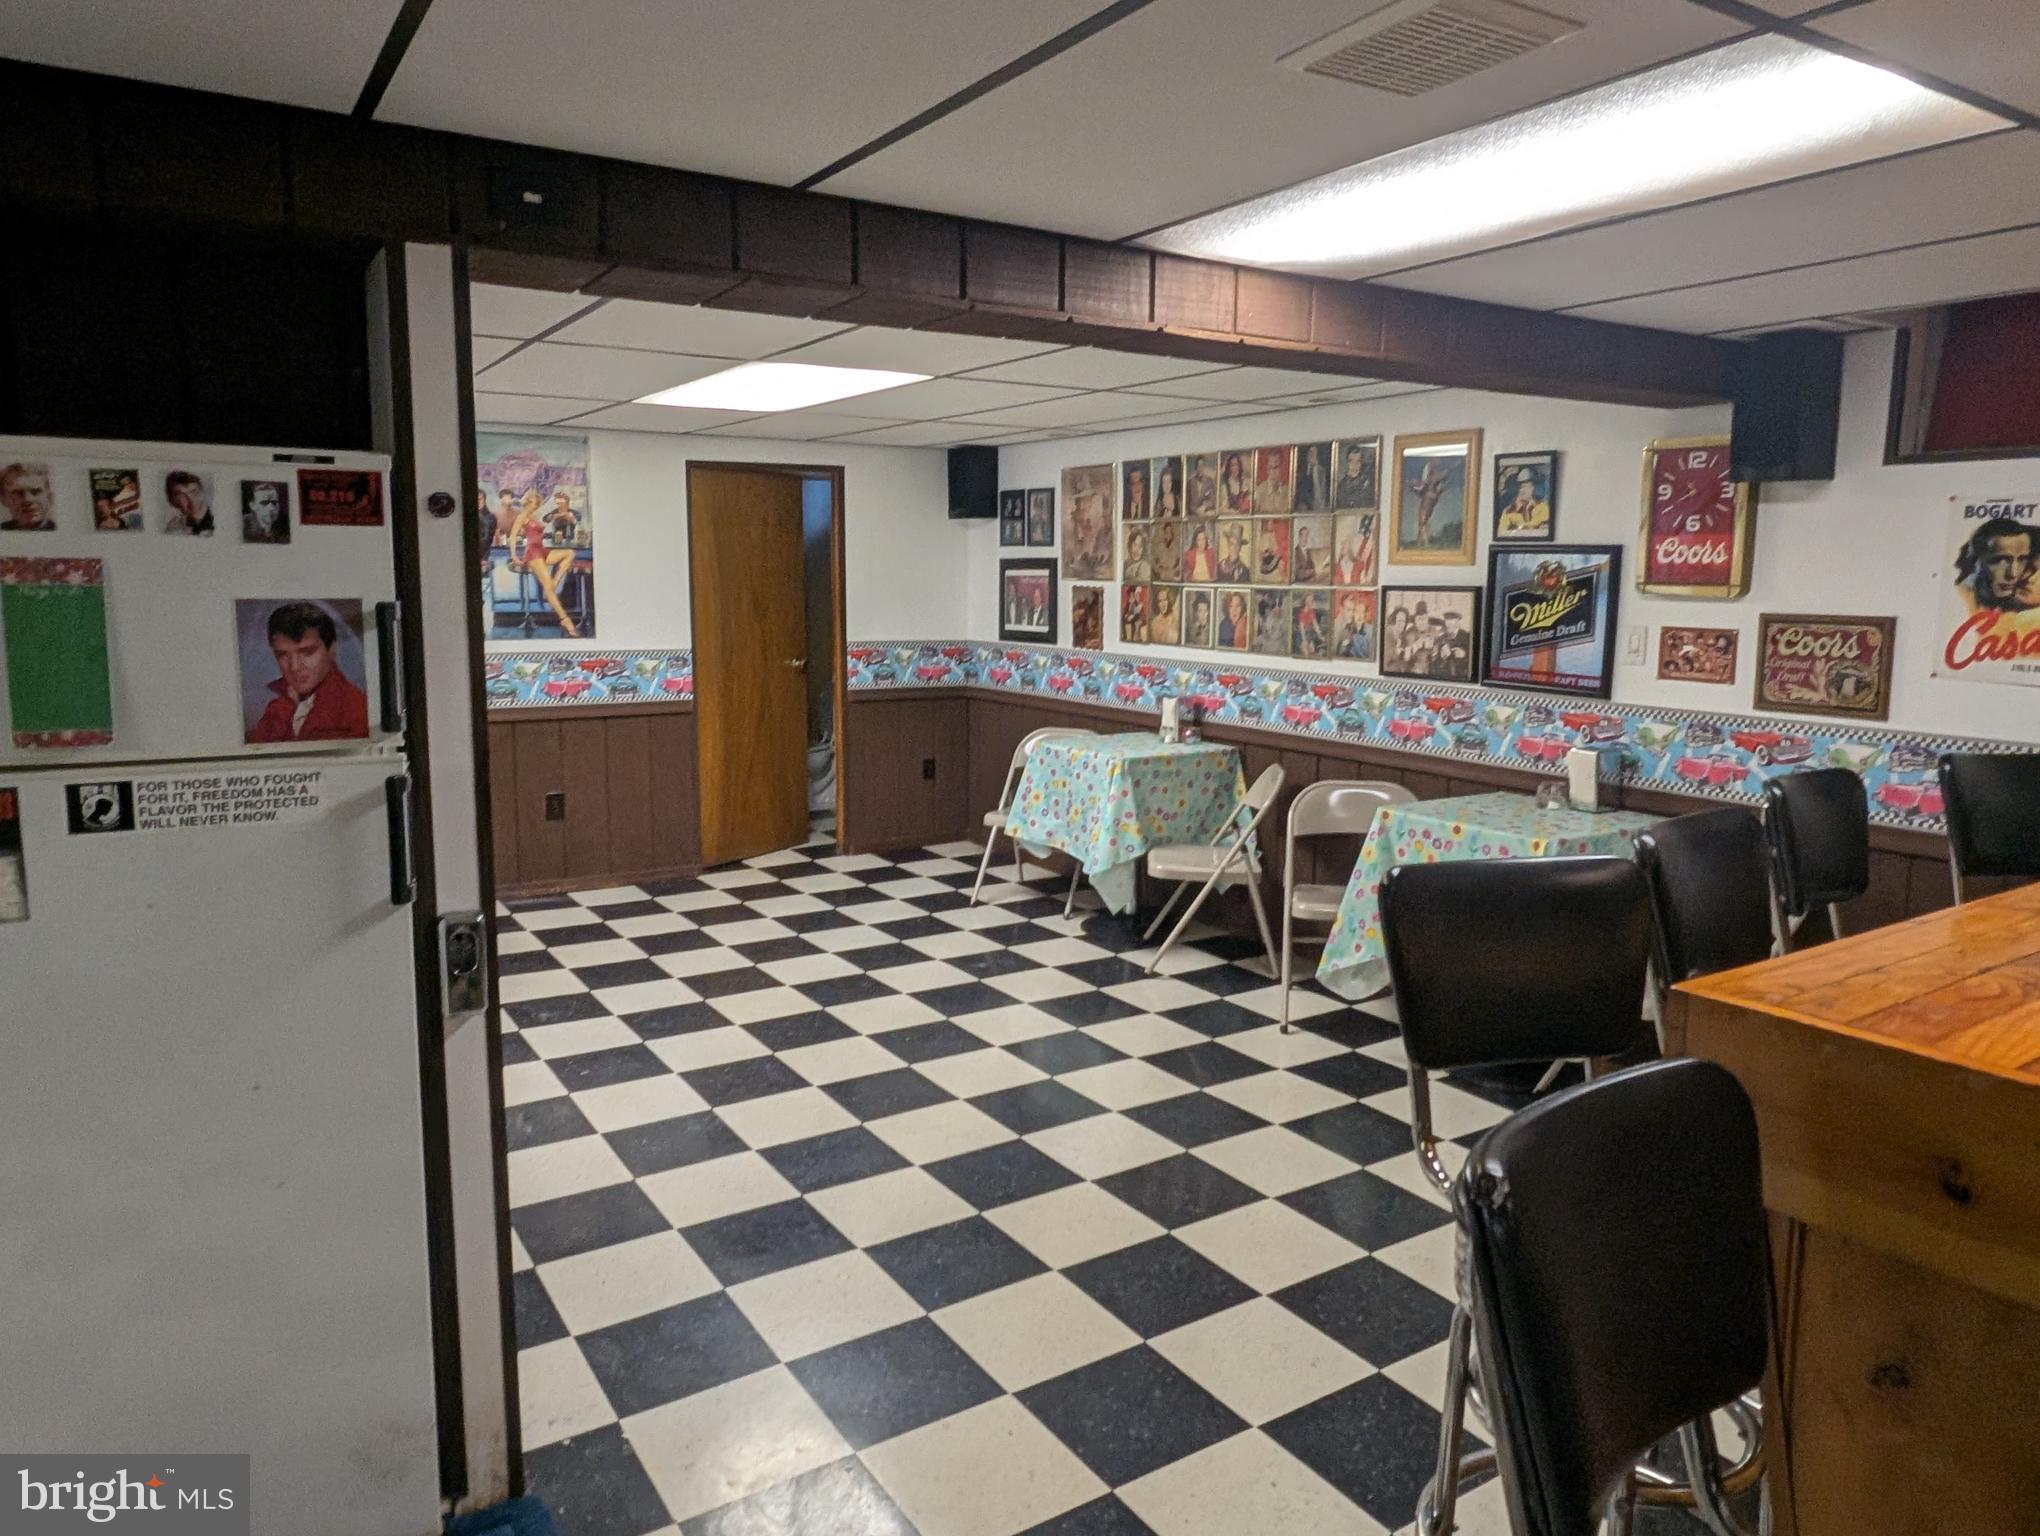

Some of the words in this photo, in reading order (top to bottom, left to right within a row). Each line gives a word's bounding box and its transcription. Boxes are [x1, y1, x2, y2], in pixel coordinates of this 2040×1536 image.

[1688, 451, 1708, 468] 12
[1657, 484, 1672, 500] 9
[1720, 481, 1736, 498] 3
[1964, 503, 2038, 519] BOGART
[1685, 514, 1701, 532] 6
[1656, 537, 1728, 565] Coors
[1510, 589, 1587, 631] Miller
[1556, 620, 1586, 637] Draft
[1776, 627, 1862, 659] Coors
[137, 781, 168, 793] FOR
[172, 777, 222, 790] THOSE
[226, 775, 260, 788] WHO
[264, 772, 320, 785] FOUGHT
[138, 793, 169, 805] FOR
[192, 788, 262, 801] FREEDOM
[267, 785, 296, 797] HAS
[299, 783, 309, 795] A
[139, 803, 197, 817] FLAVOR
[201, 801, 230, 813] THE
[234, 796, 319, 811] PROTECTED
[140, 818, 176, 830] WILL
[179, 813, 229, 827] NEVER
